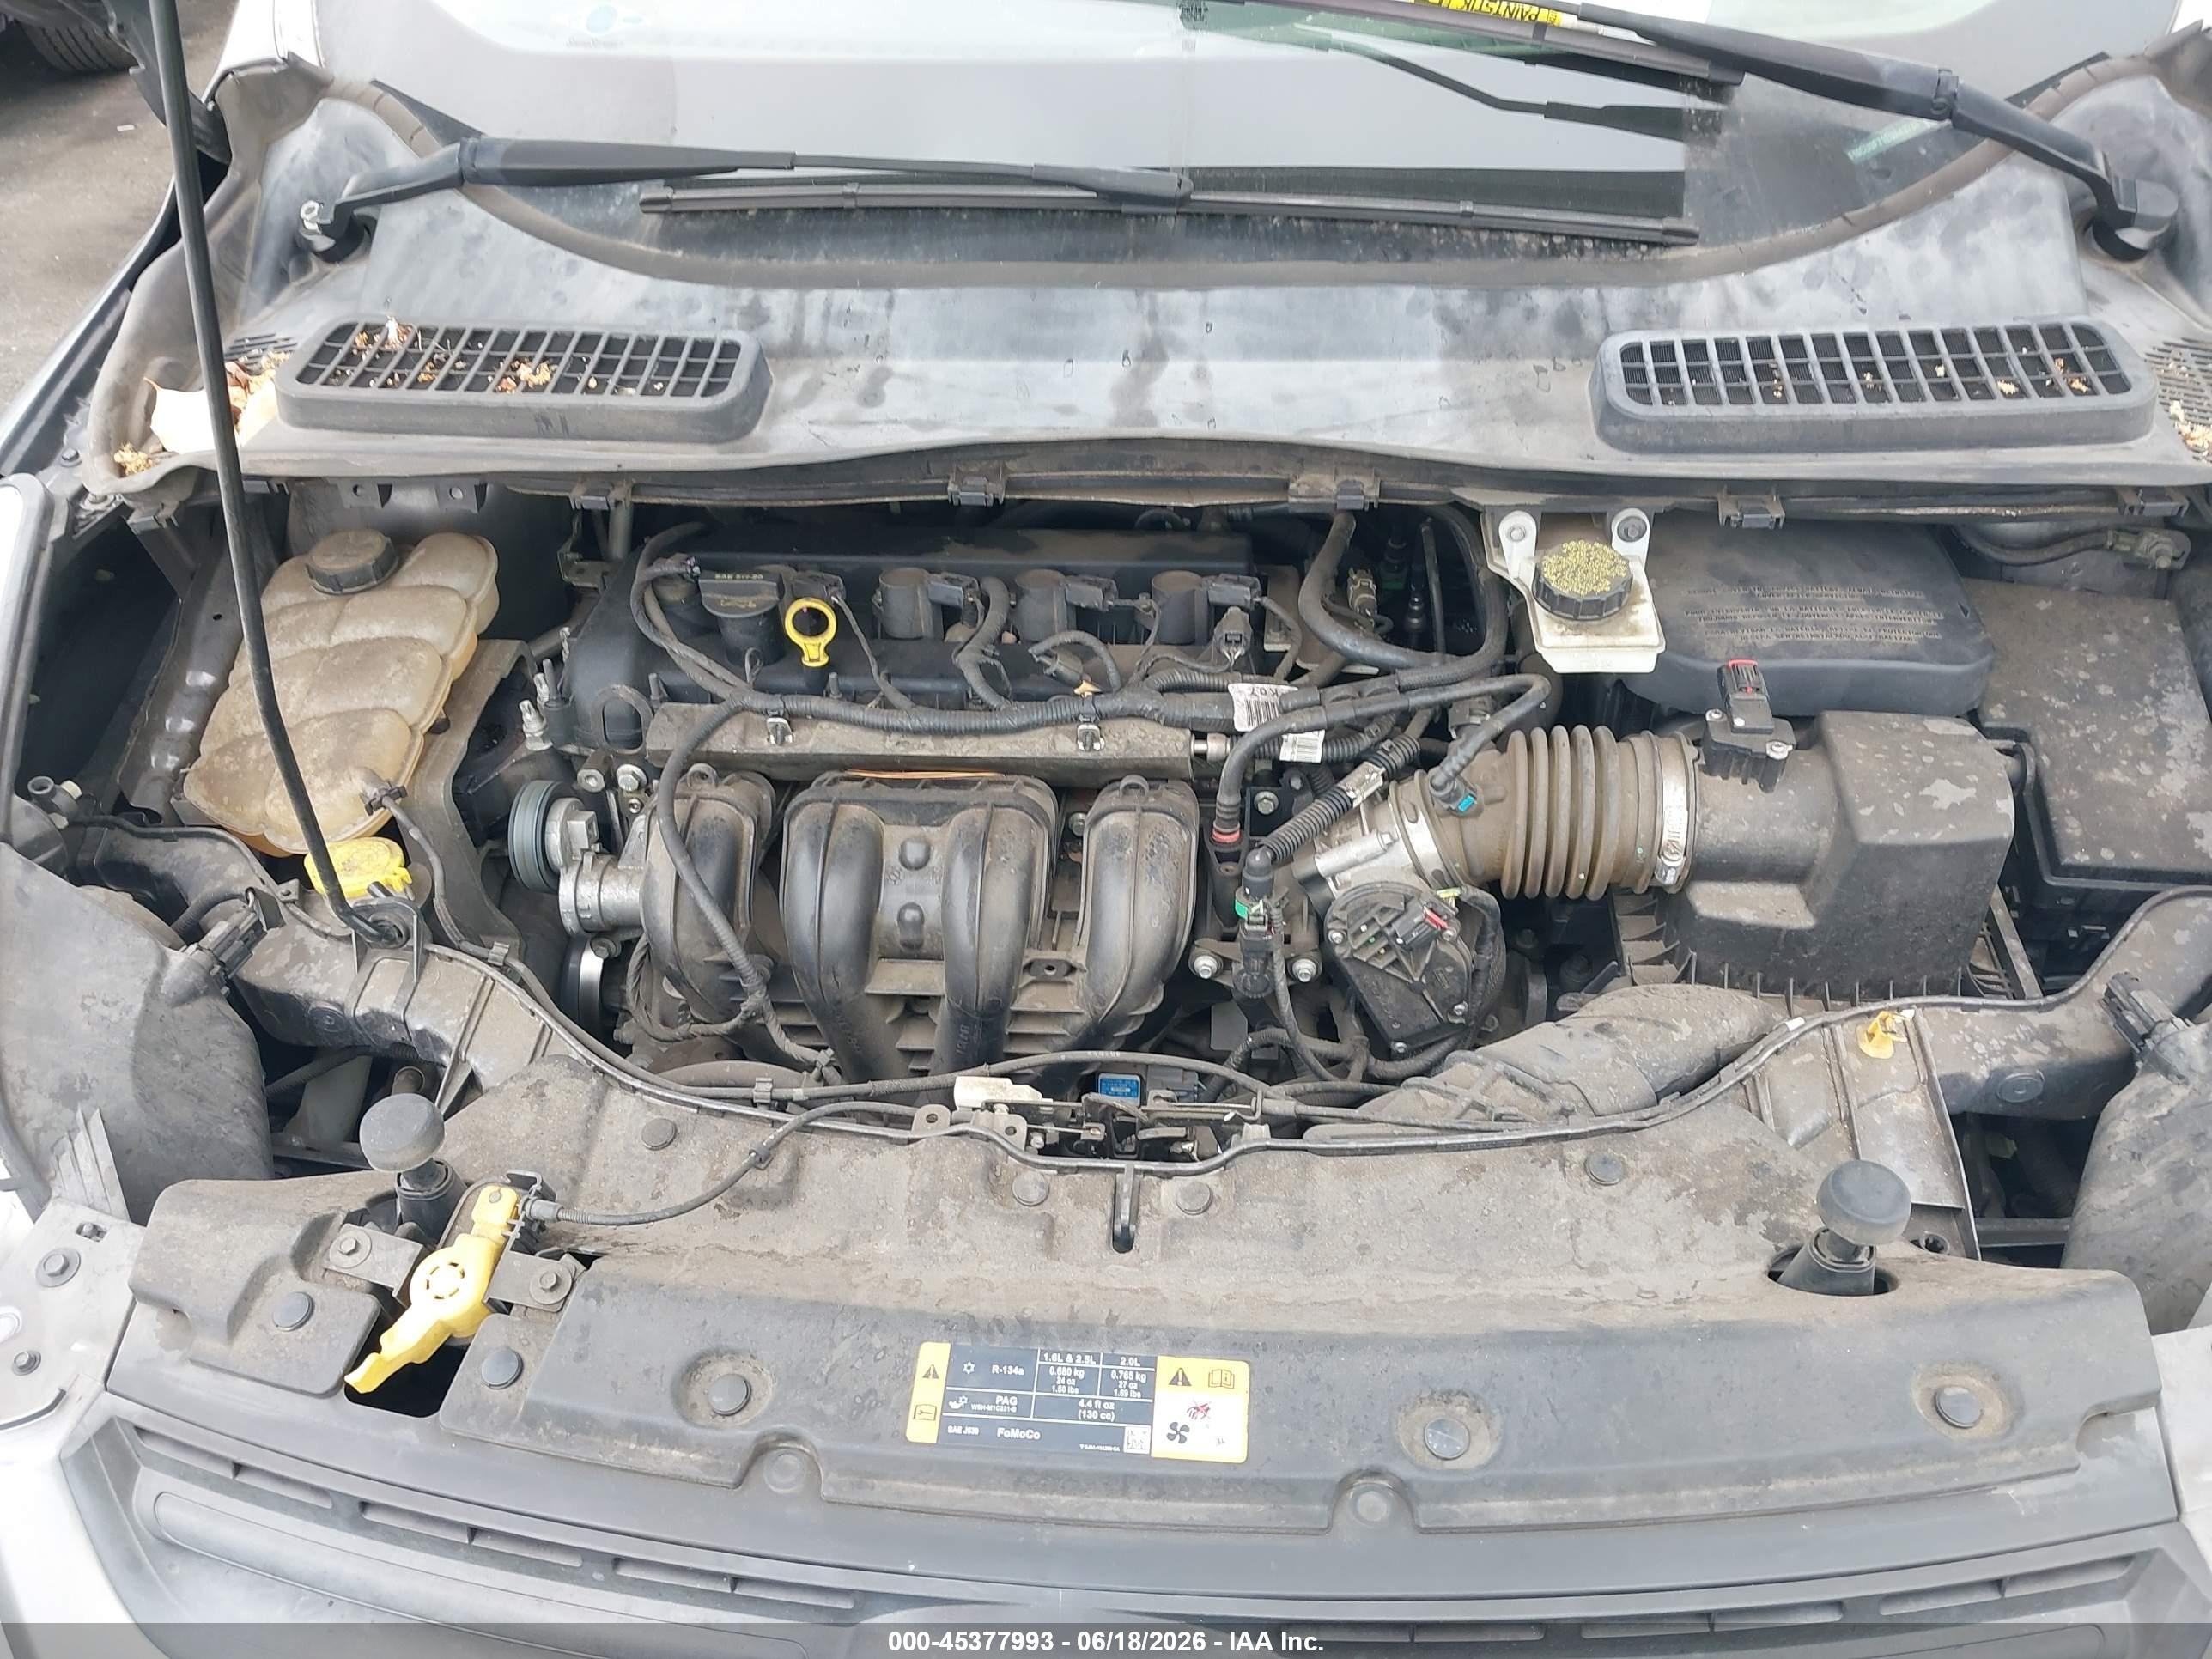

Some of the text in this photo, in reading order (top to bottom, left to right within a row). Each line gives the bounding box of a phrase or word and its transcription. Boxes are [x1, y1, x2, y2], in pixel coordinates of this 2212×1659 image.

[1120, 1357, 1140, 1366] 2.0L
[992, 1364, 1024, 1376] R-134a
[1073, 1368, 1085, 1379] kg
[1135, 1371, 1146, 1382] kg
[995, 1395, 1018, 1406] PAG
[1078, 1399, 1093, 1409] 4.4
[1078, 1410, 1115, 1422] (130 cc)
[997, 1427, 1042, 1440] FoMoCo
